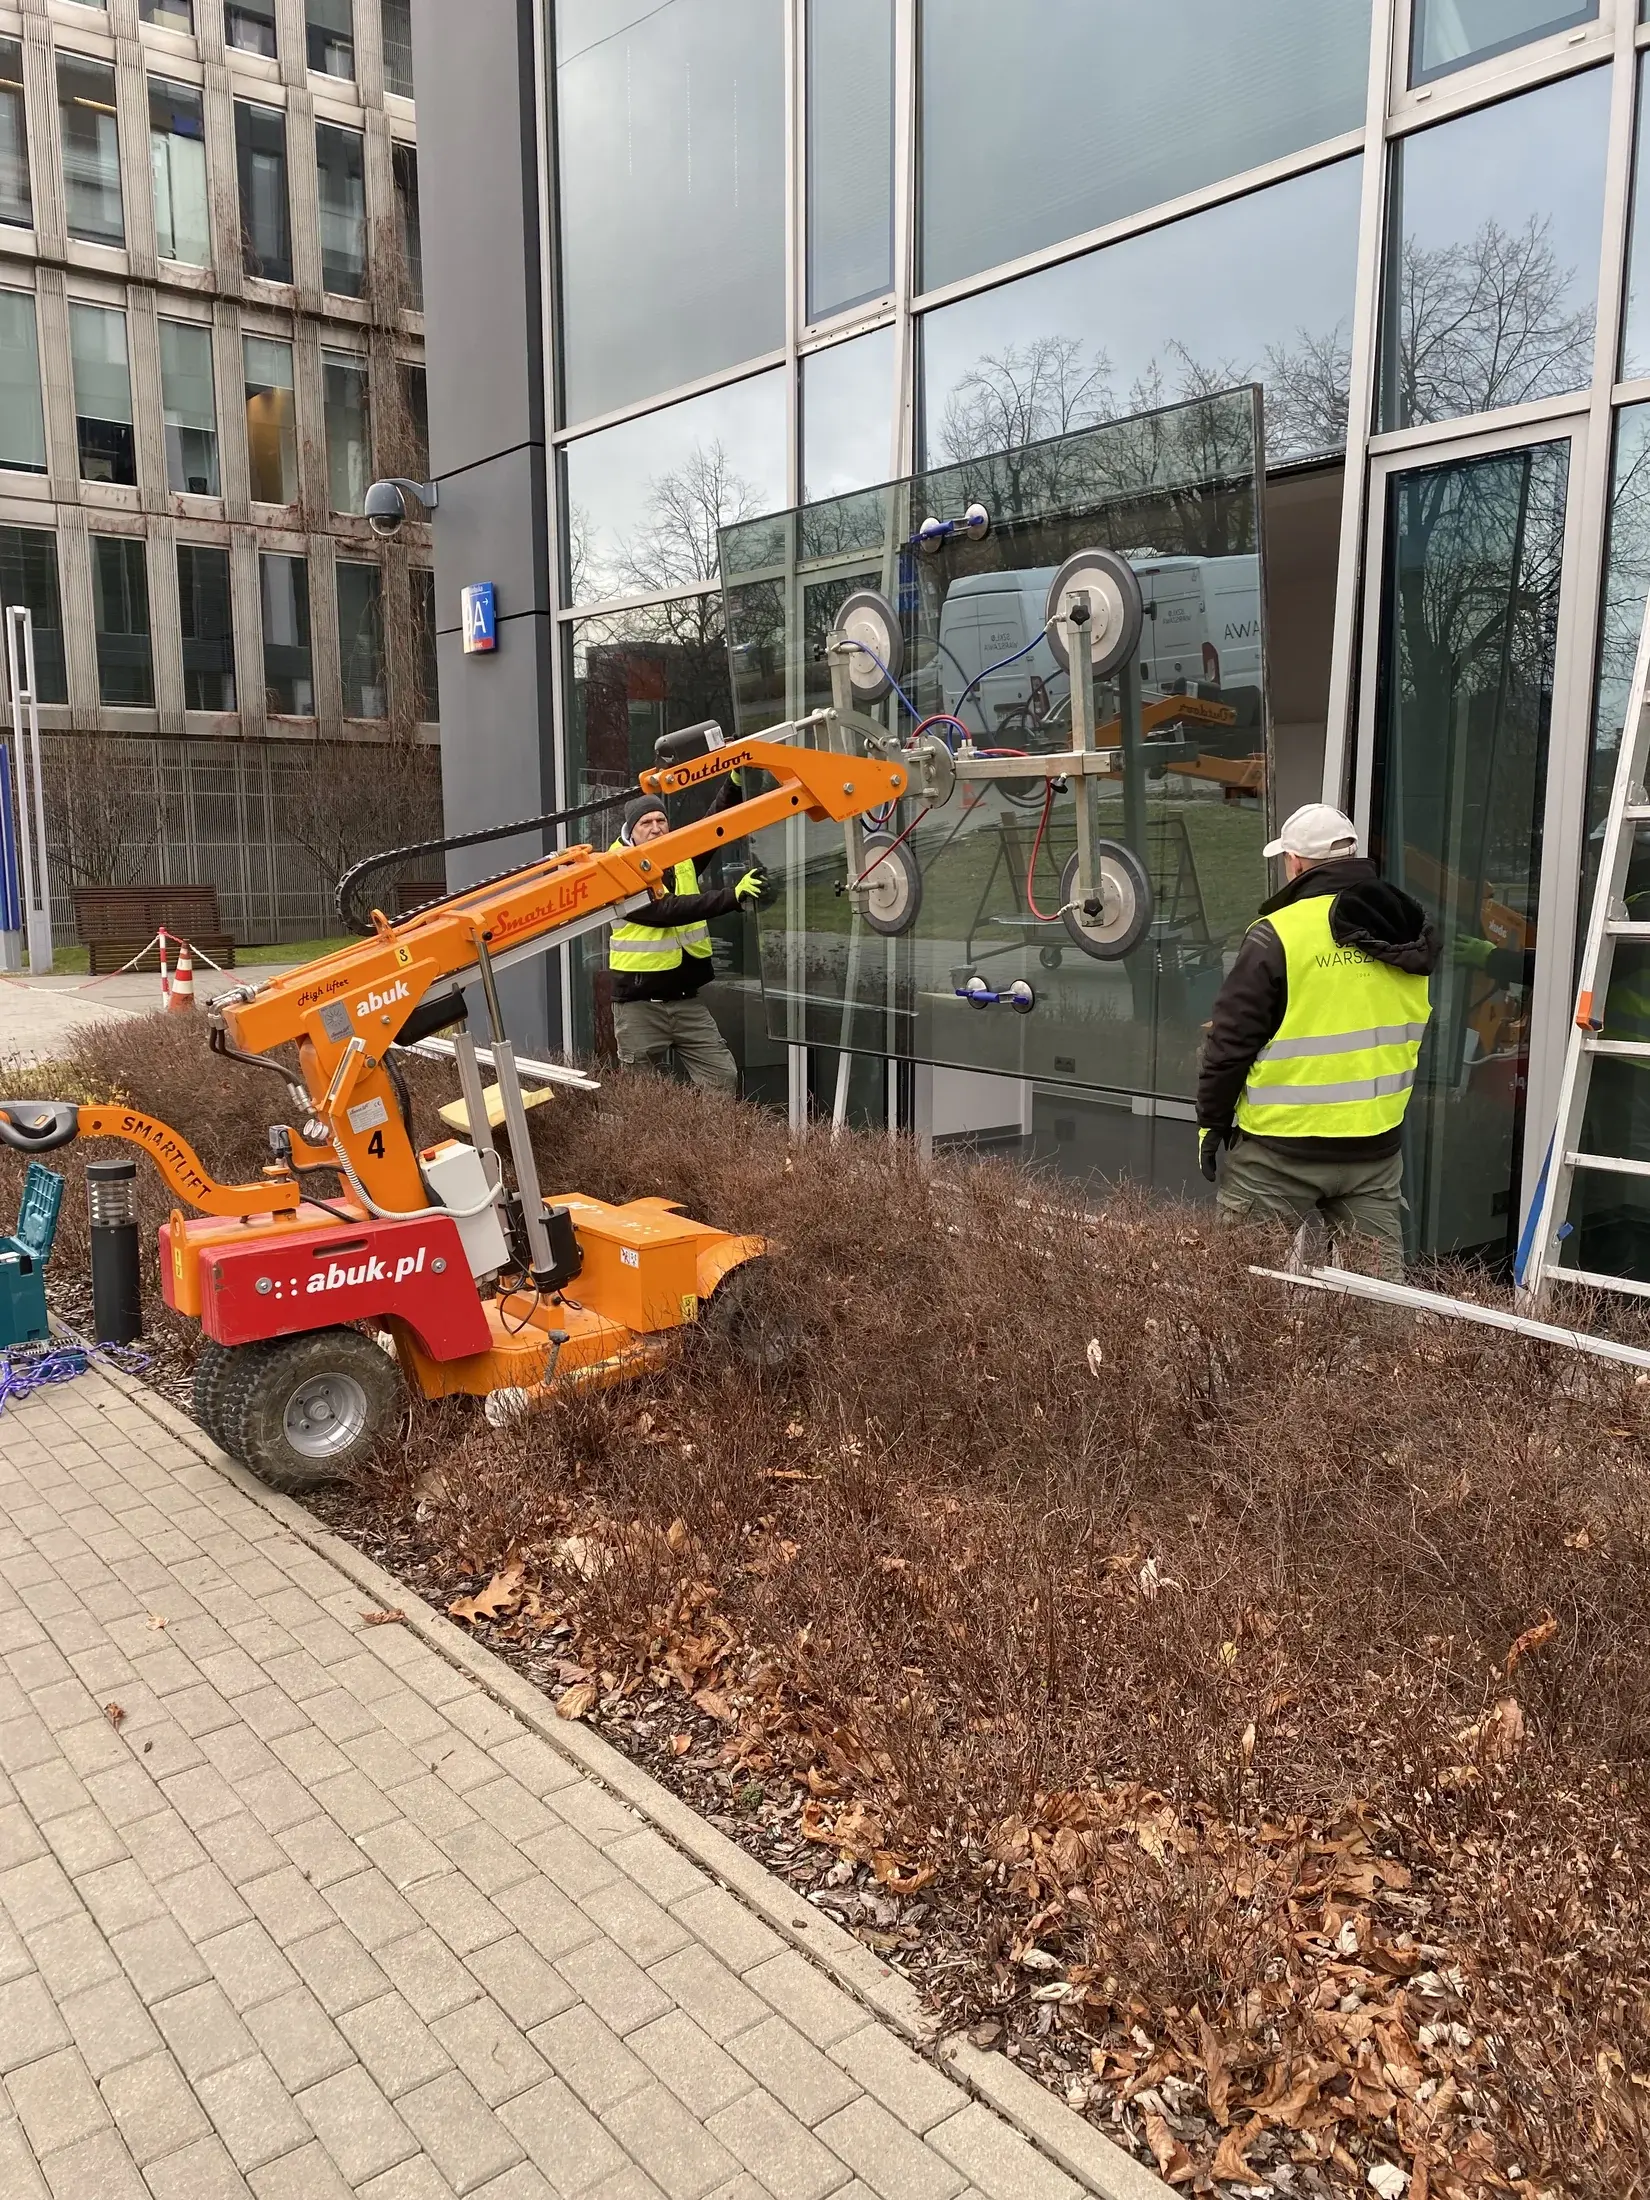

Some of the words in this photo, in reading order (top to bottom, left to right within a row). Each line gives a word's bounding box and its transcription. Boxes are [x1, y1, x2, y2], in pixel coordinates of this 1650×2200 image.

[674, 751, 753, 786] Outdoor
[489, 899, 557, 937] Smart
[298, 989, 323, 1007] High
[326, 978, 349, 994] lifter
[356, 979, 410, 1018] abuk
[121, 1116, 212, 1200] SMARTLIFT
[367, 1129, 386, 1159] 4
[305, 1246, 426, 1295] abuk.pl
